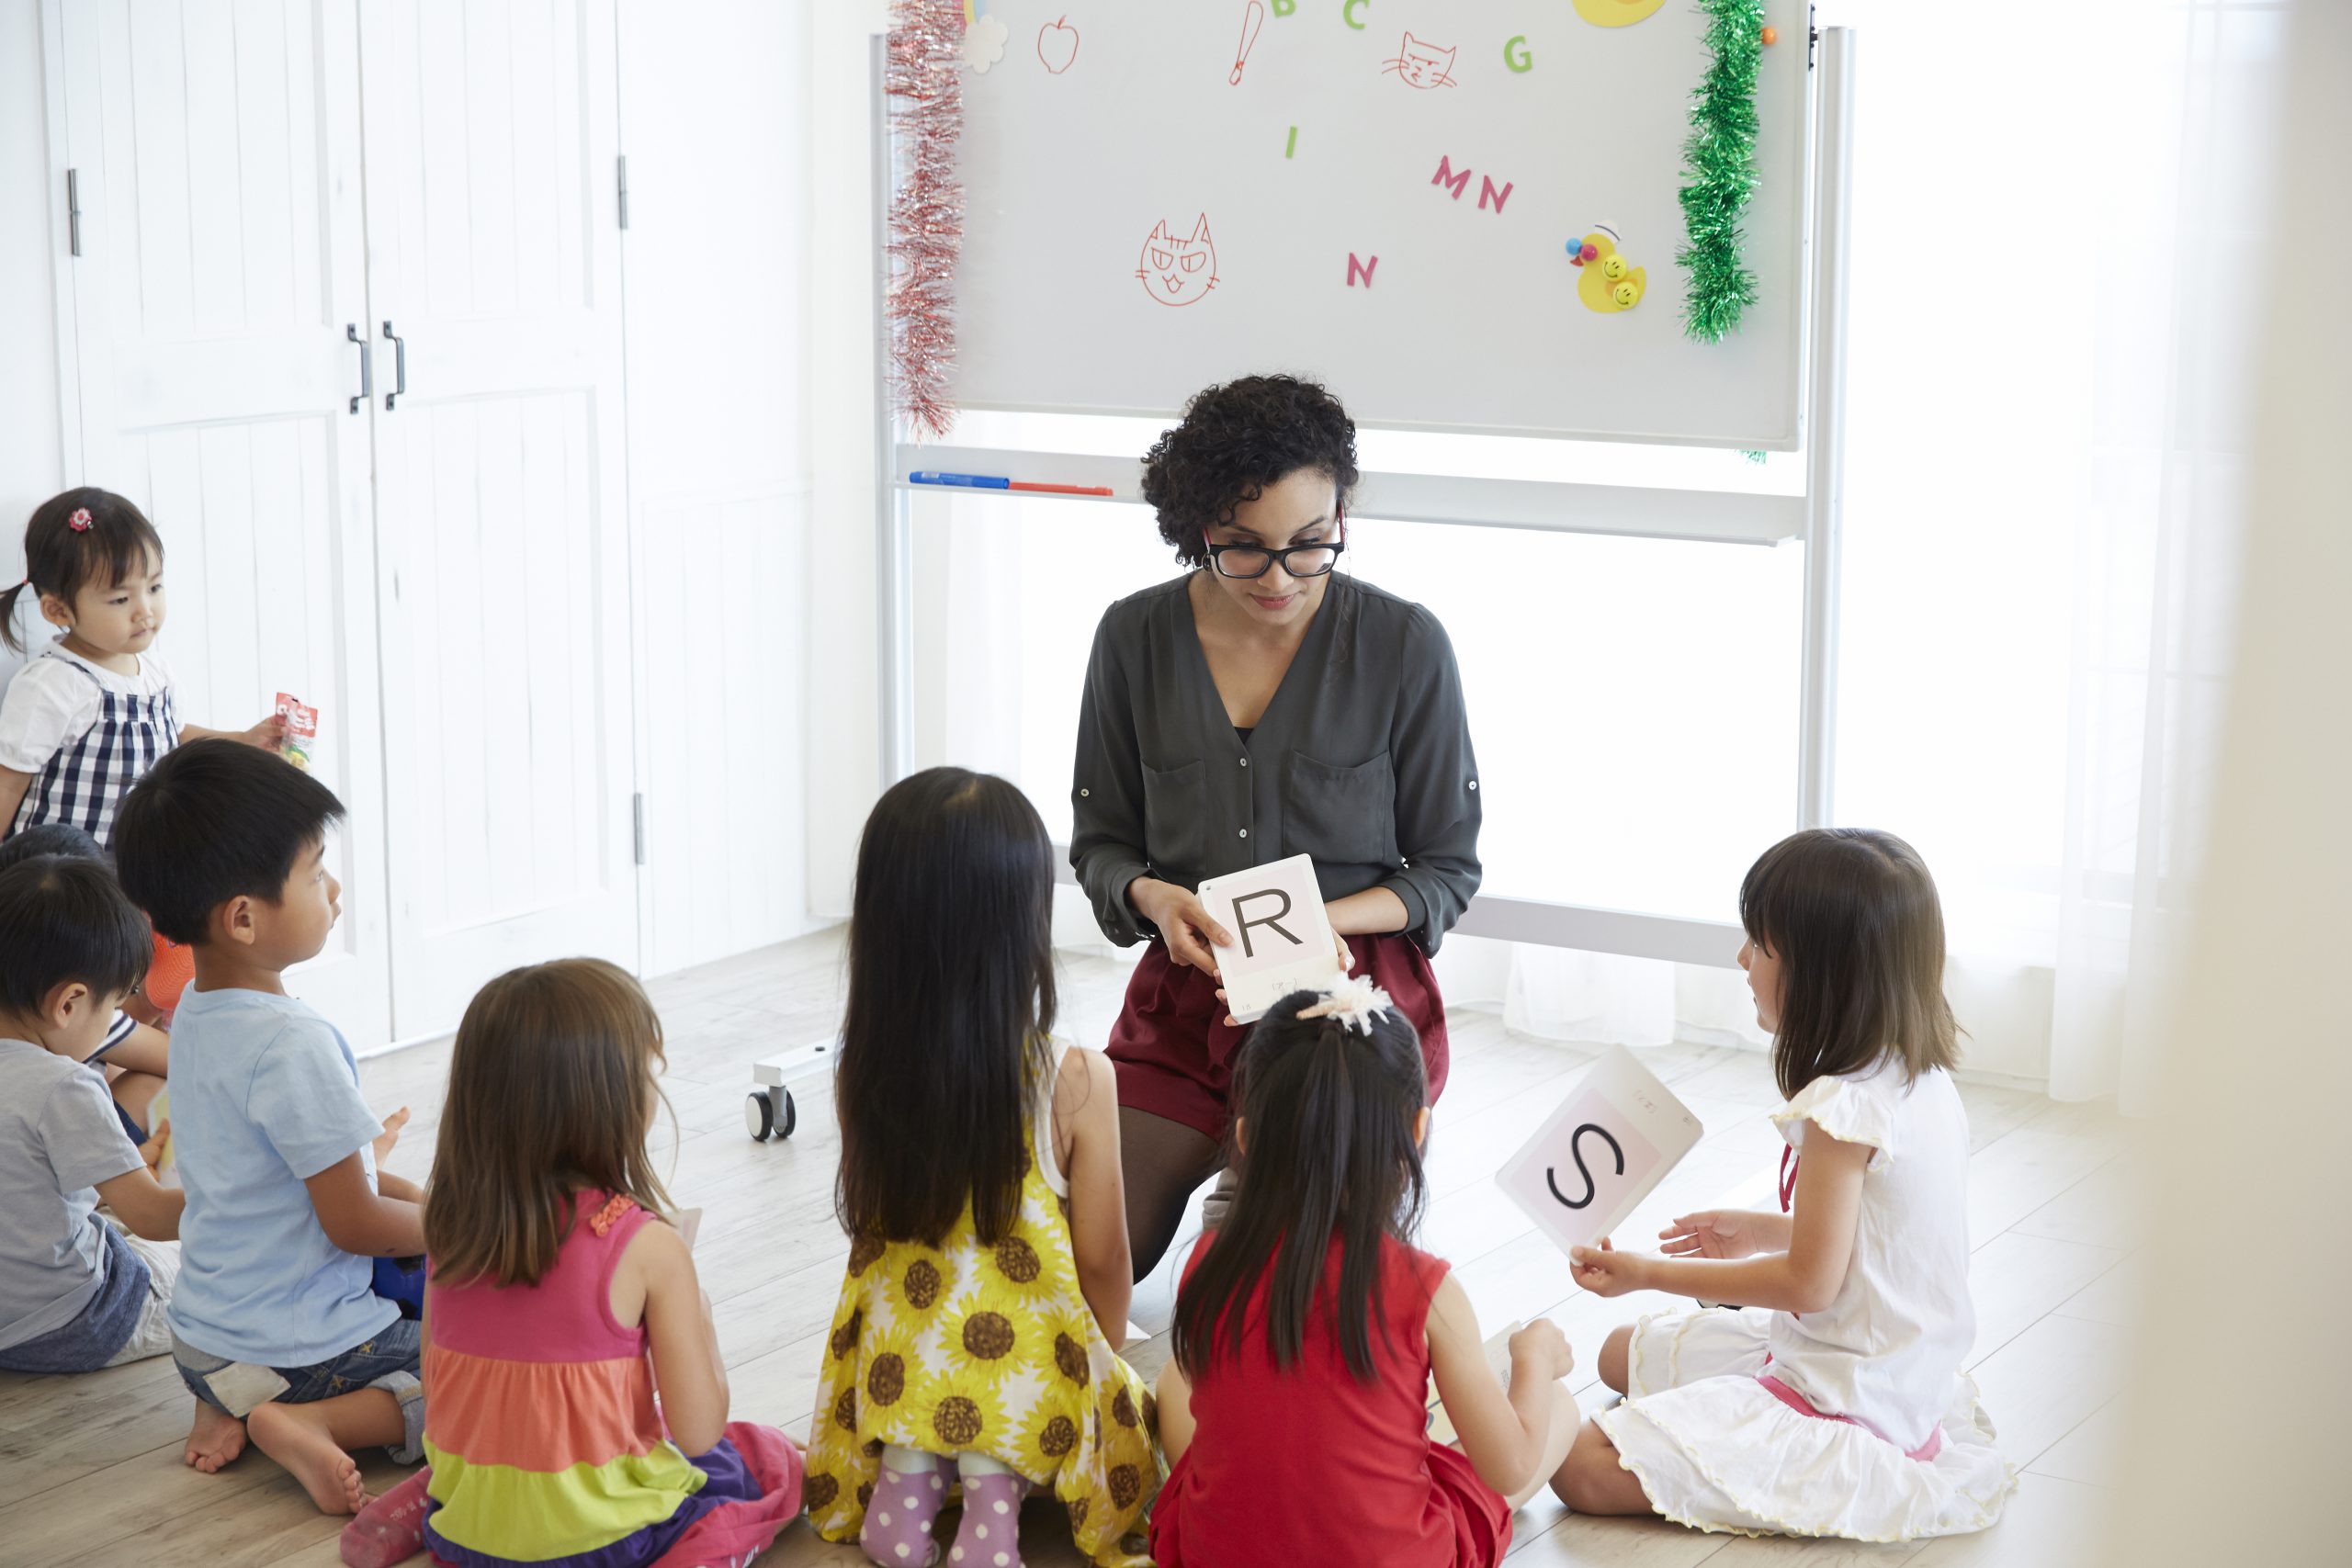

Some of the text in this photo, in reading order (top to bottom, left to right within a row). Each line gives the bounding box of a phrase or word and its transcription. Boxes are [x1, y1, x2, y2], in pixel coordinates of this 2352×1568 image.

[1342, 0, 1370, 29] C
[1503, 35, 1532, 73] G
[1347, 253, 1378, 288] N
[1232, 888, 1304, 958] R
[1546, 1122, 1625, 1210] S
